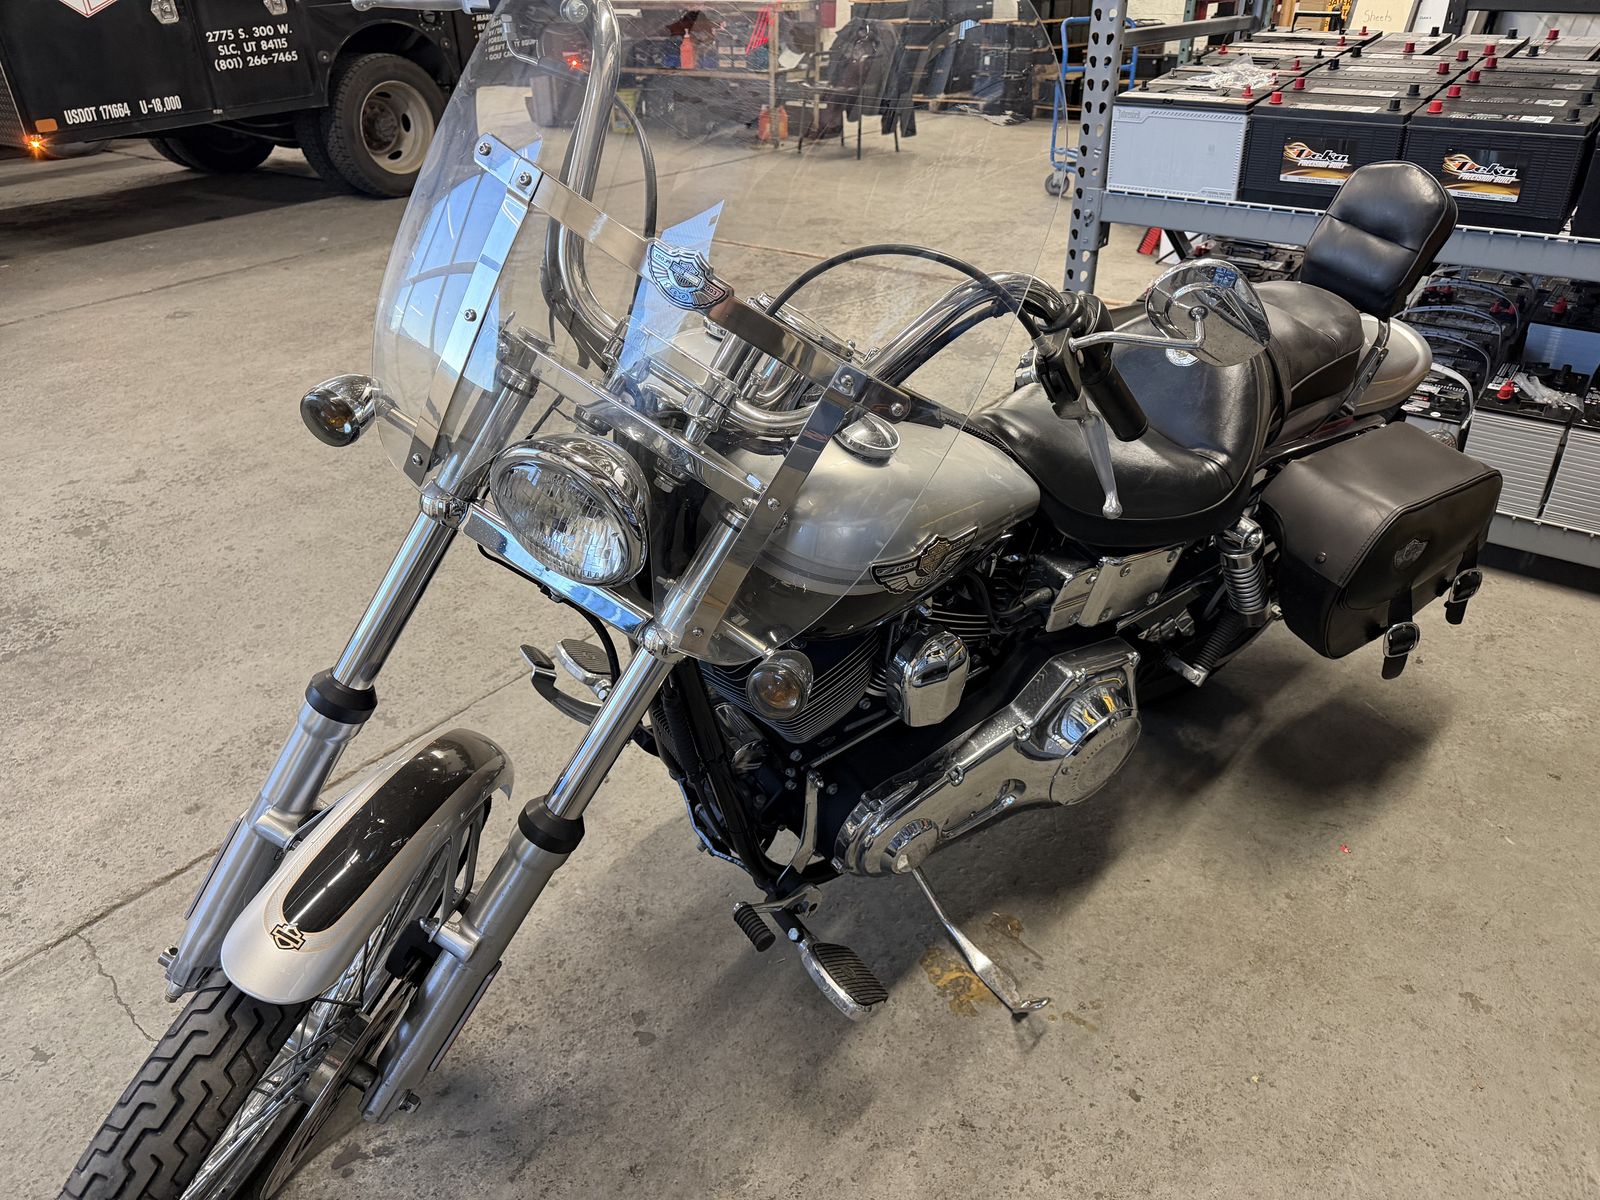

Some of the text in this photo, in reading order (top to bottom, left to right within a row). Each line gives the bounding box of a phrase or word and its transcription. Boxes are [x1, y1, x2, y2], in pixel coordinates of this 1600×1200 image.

[1362, 9, 1393, 23] Sheets
[205, 23, 293, 43] 2775 S. 300 W.
[217, 38, 288, 56] SLC, UT 84115
[215, 51, 299, 72] (801) 266-7465
[64, 102, 131, 125] USDOT 171664
[139, 95, 182, 114] U-18,000
